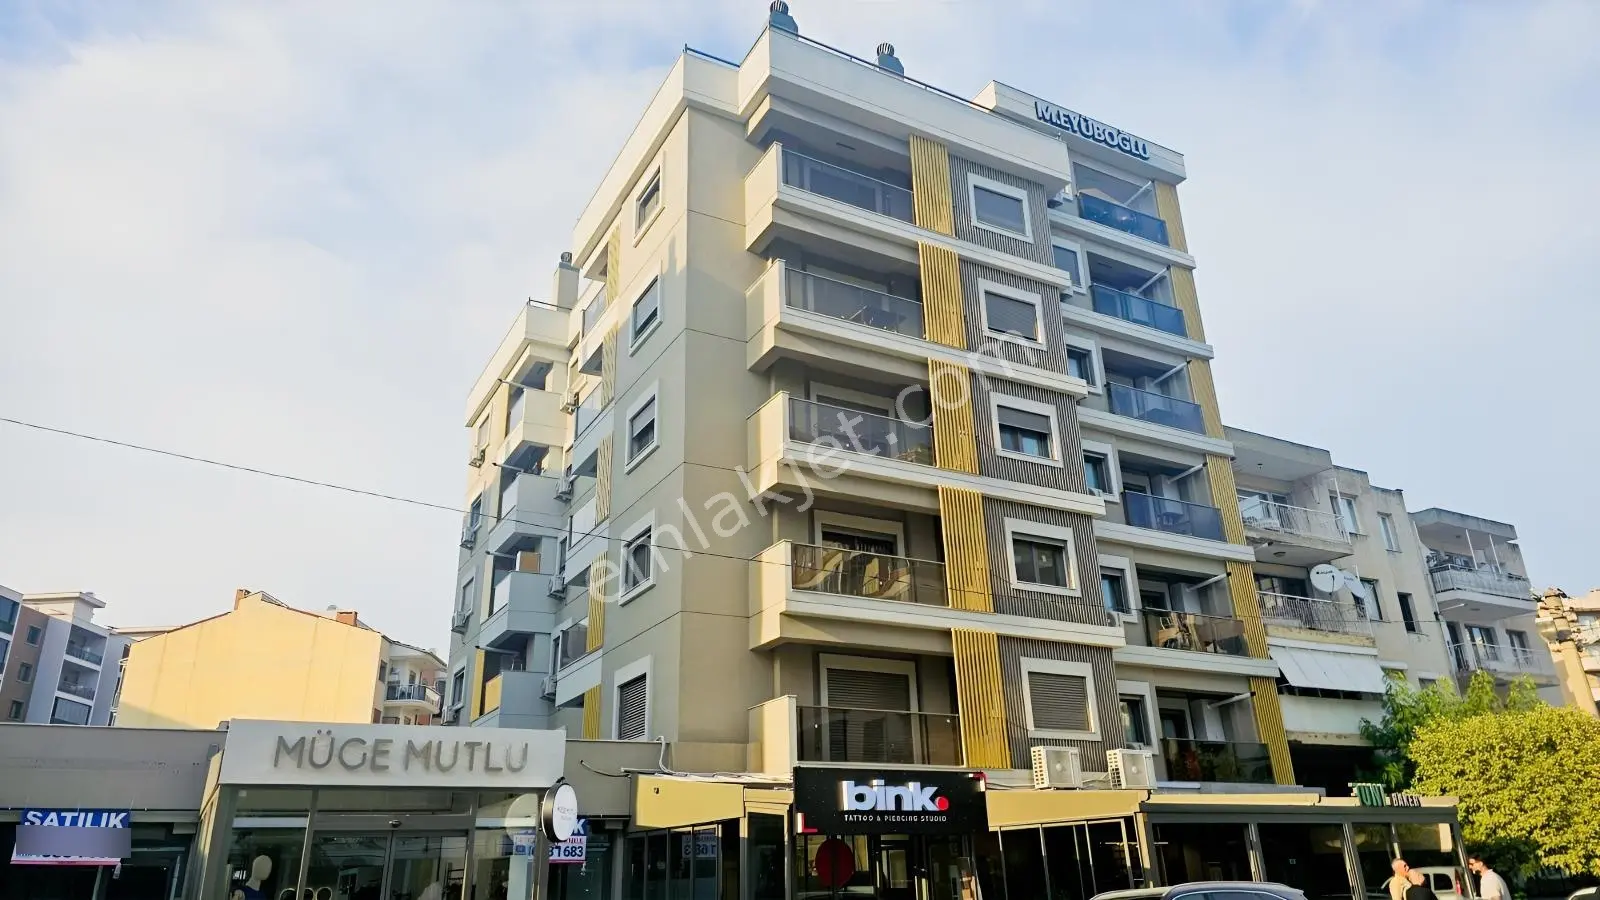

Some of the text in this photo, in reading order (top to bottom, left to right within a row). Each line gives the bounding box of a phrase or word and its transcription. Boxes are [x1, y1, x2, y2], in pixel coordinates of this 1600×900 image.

[274, 729, 529, 773] MÜGE MUTLU
[25, 811, 127, 828] SATILIK
[844, 814, 874, 822] TATTOO
